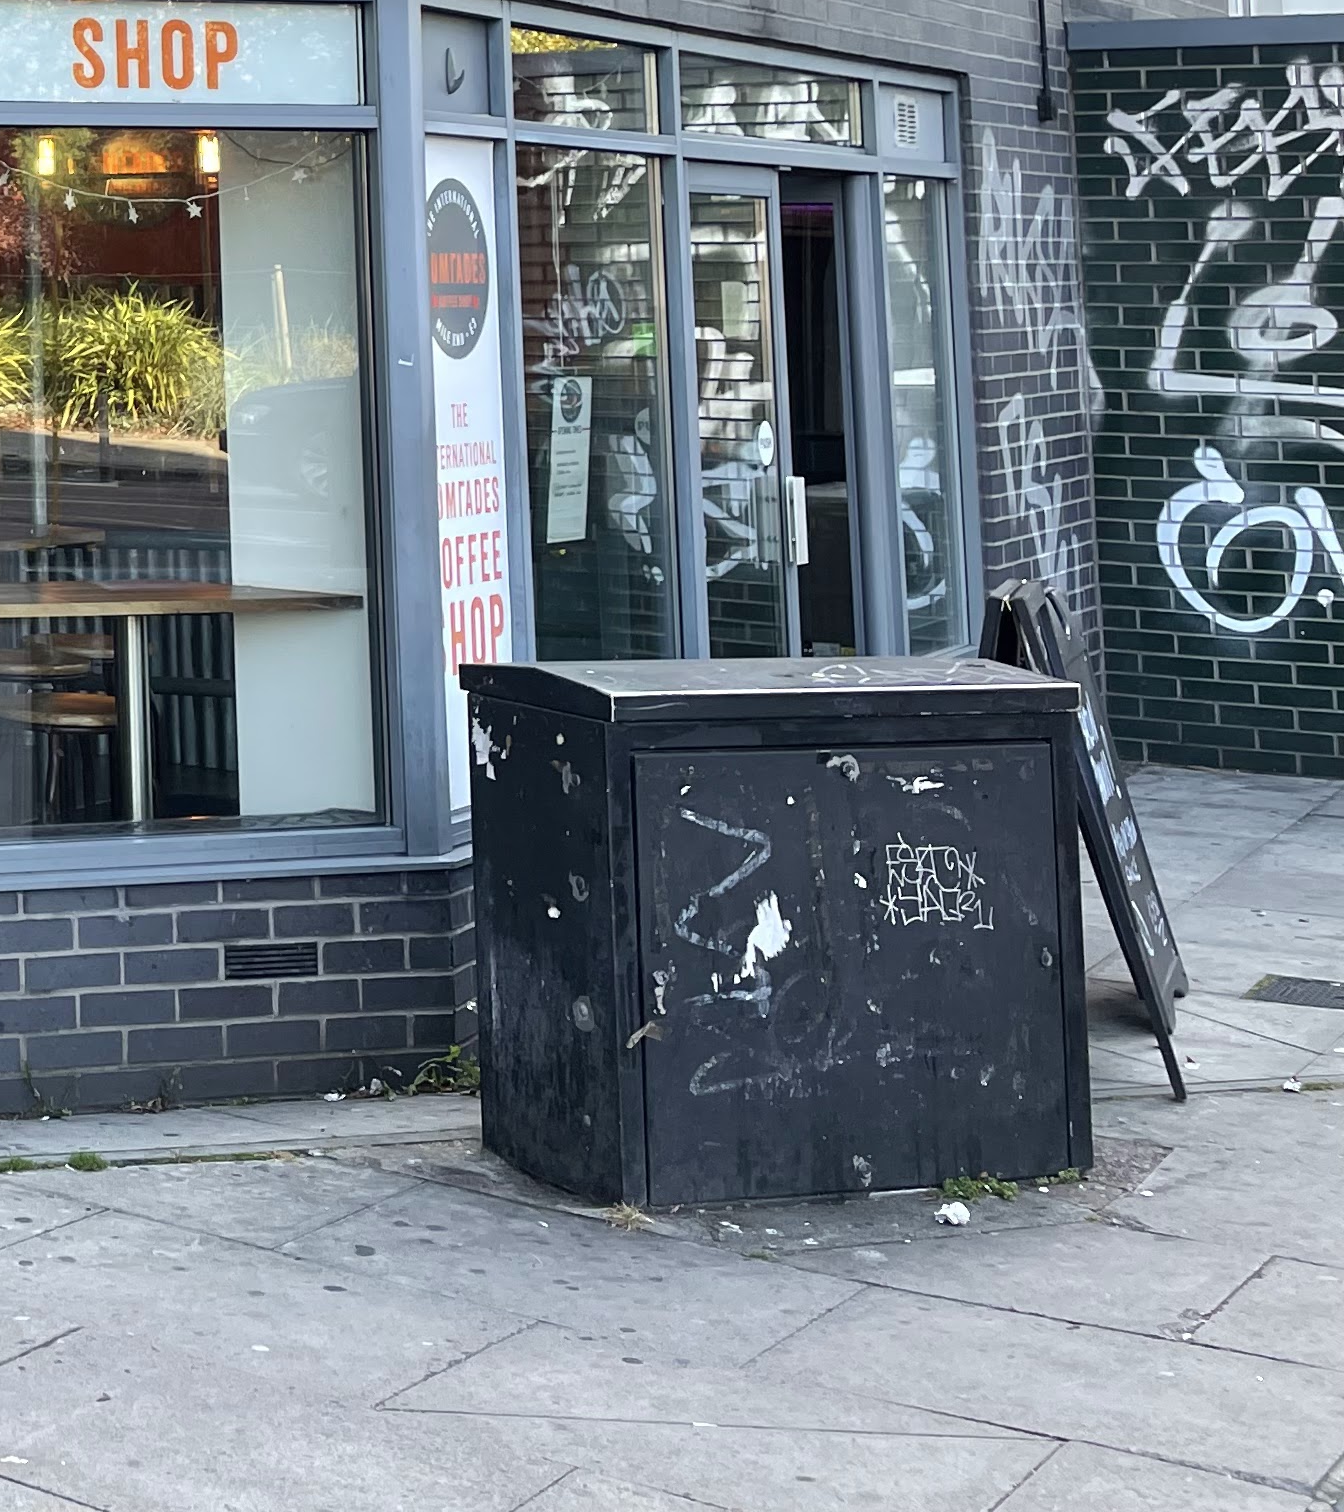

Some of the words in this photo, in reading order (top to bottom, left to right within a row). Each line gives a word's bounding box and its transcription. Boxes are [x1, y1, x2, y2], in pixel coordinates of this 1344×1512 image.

[71, 16, 240, 91] SHOP
[450, 402, 469, 429] THE
[437, 440, 497, 470] ERNATIONAL
[441, 530, 503, 590] OFFEE
[442, 592, 504, 676] HOP
